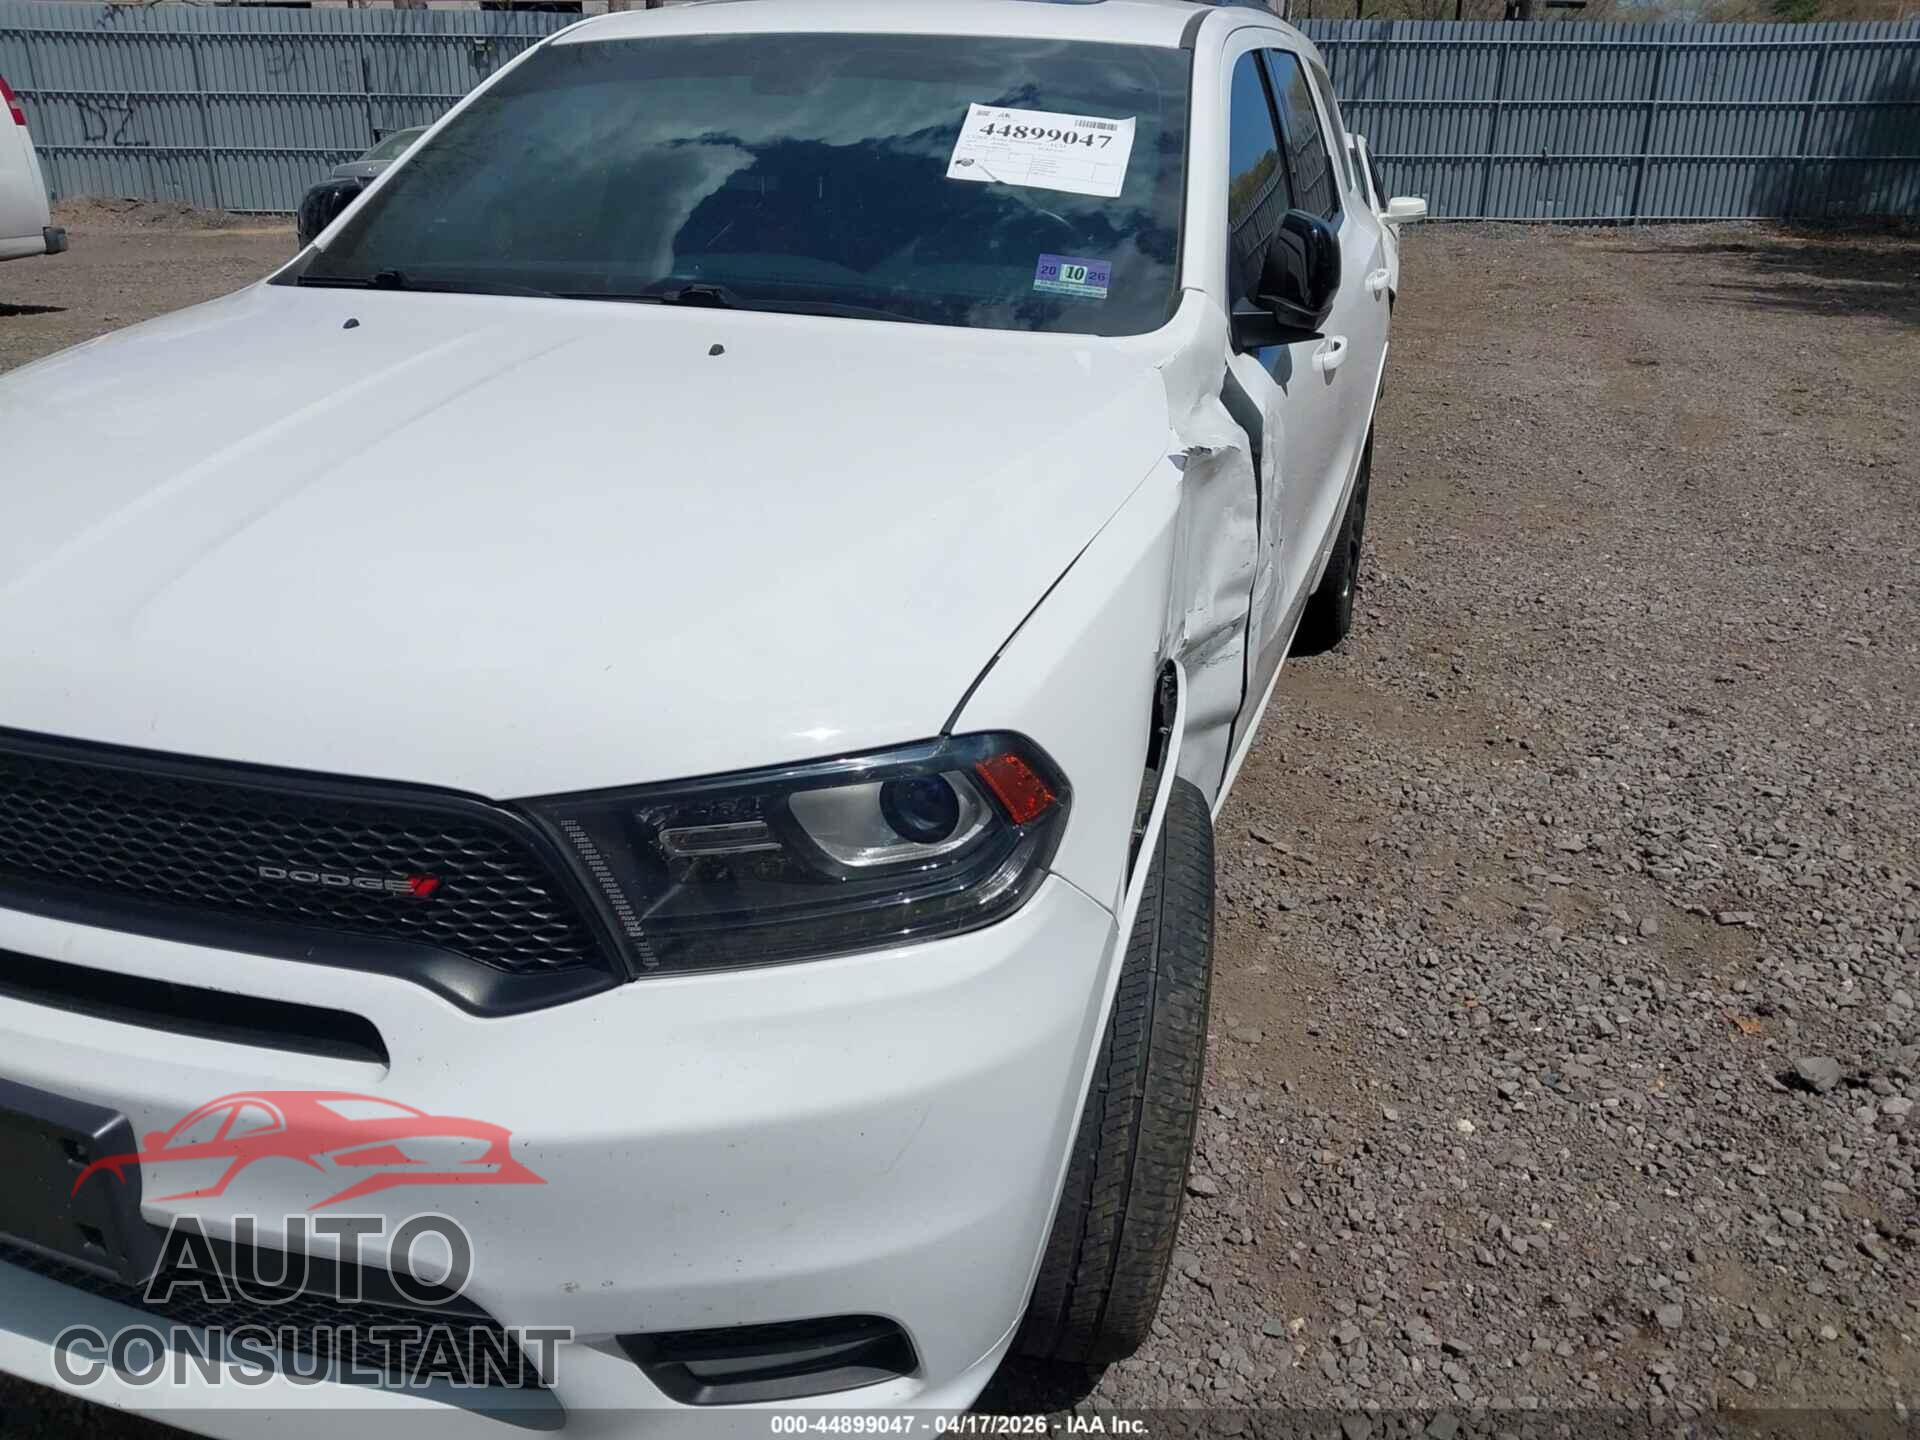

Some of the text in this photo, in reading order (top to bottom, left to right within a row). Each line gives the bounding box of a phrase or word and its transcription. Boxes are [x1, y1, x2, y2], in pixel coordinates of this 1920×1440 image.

[979, 122, 1113, 149] 44899047
[1041, 264, 1106, 282] 20 10 26
[258, 866, 415, 893] DODGE
